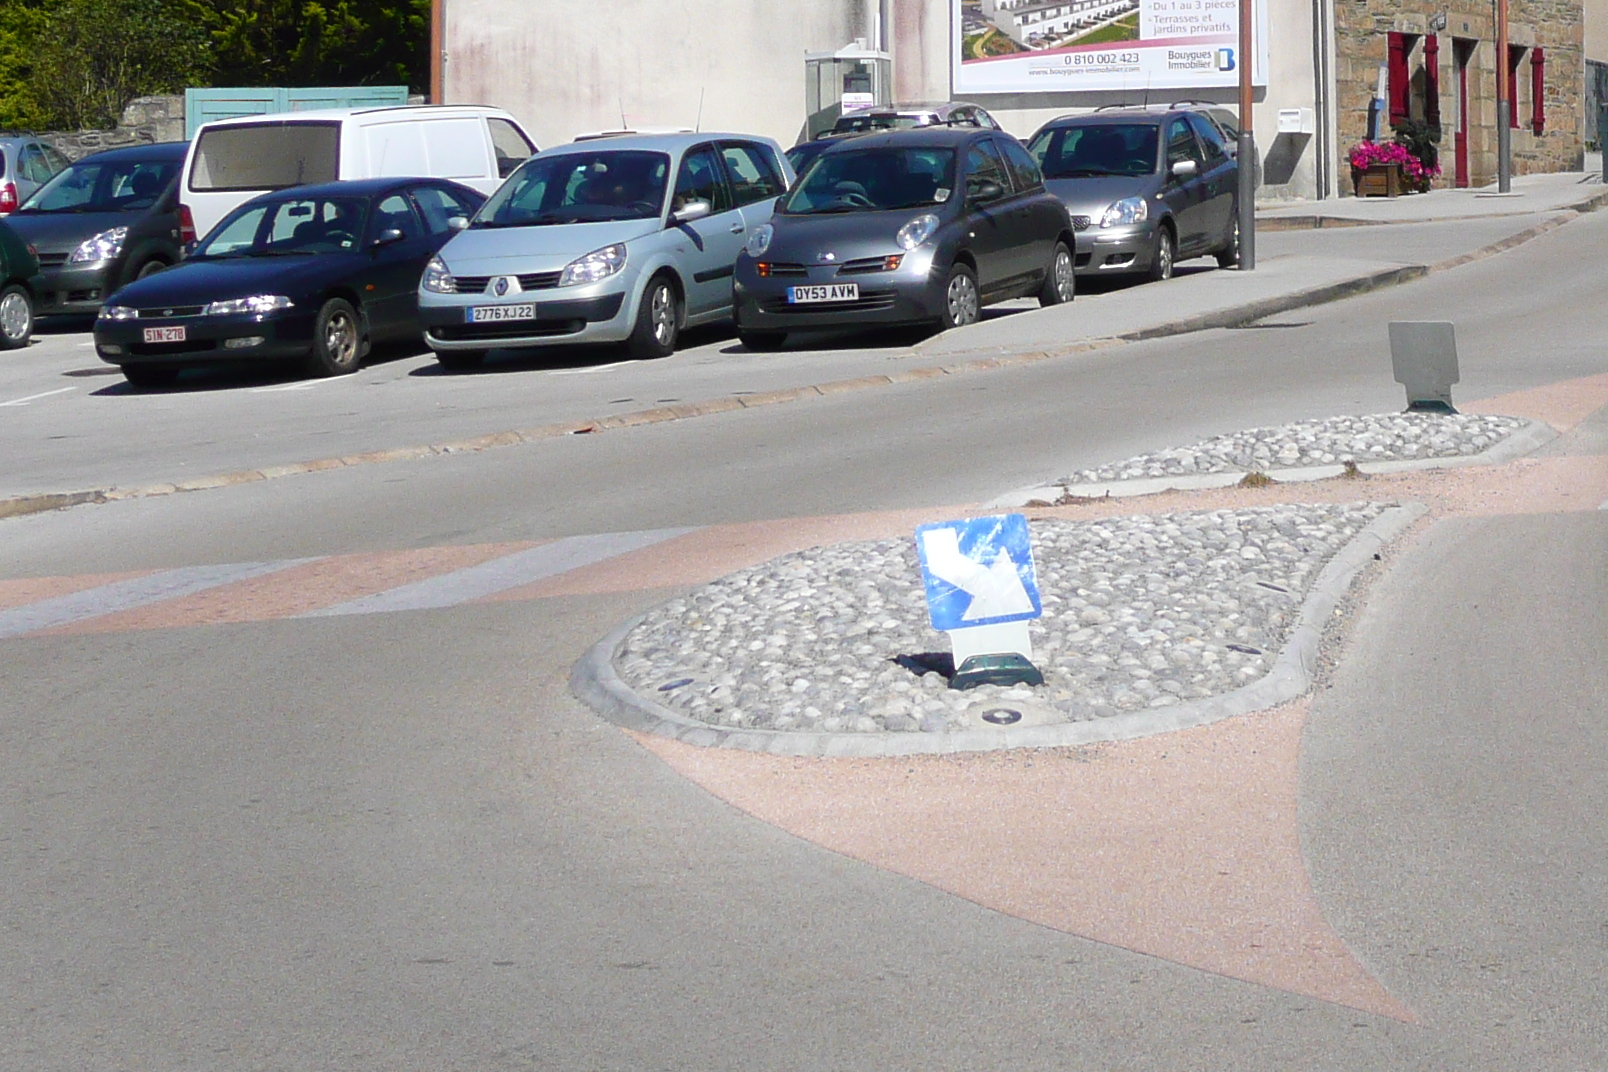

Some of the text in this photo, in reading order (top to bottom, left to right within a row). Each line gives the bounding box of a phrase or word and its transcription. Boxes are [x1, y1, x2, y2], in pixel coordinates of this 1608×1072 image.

[1153, 2, 1167, 11] Du
[1180, 2, 1192, 10] au
[1195, 1, 1202, 10] 3
[1154, 14, 1212, 24] Terrasses et
[1153, 22, 1232, 36] jardins privatifs
[1064, 53, 1140, 65] 0 810 002 423
[1168, 50, 1212, 60] Bouygues
[1168, 60, 1211, 70] Immobilier
[830, 285, 855, 298] AVM
[474, 306, 532, 320] 2776 XJ 22
